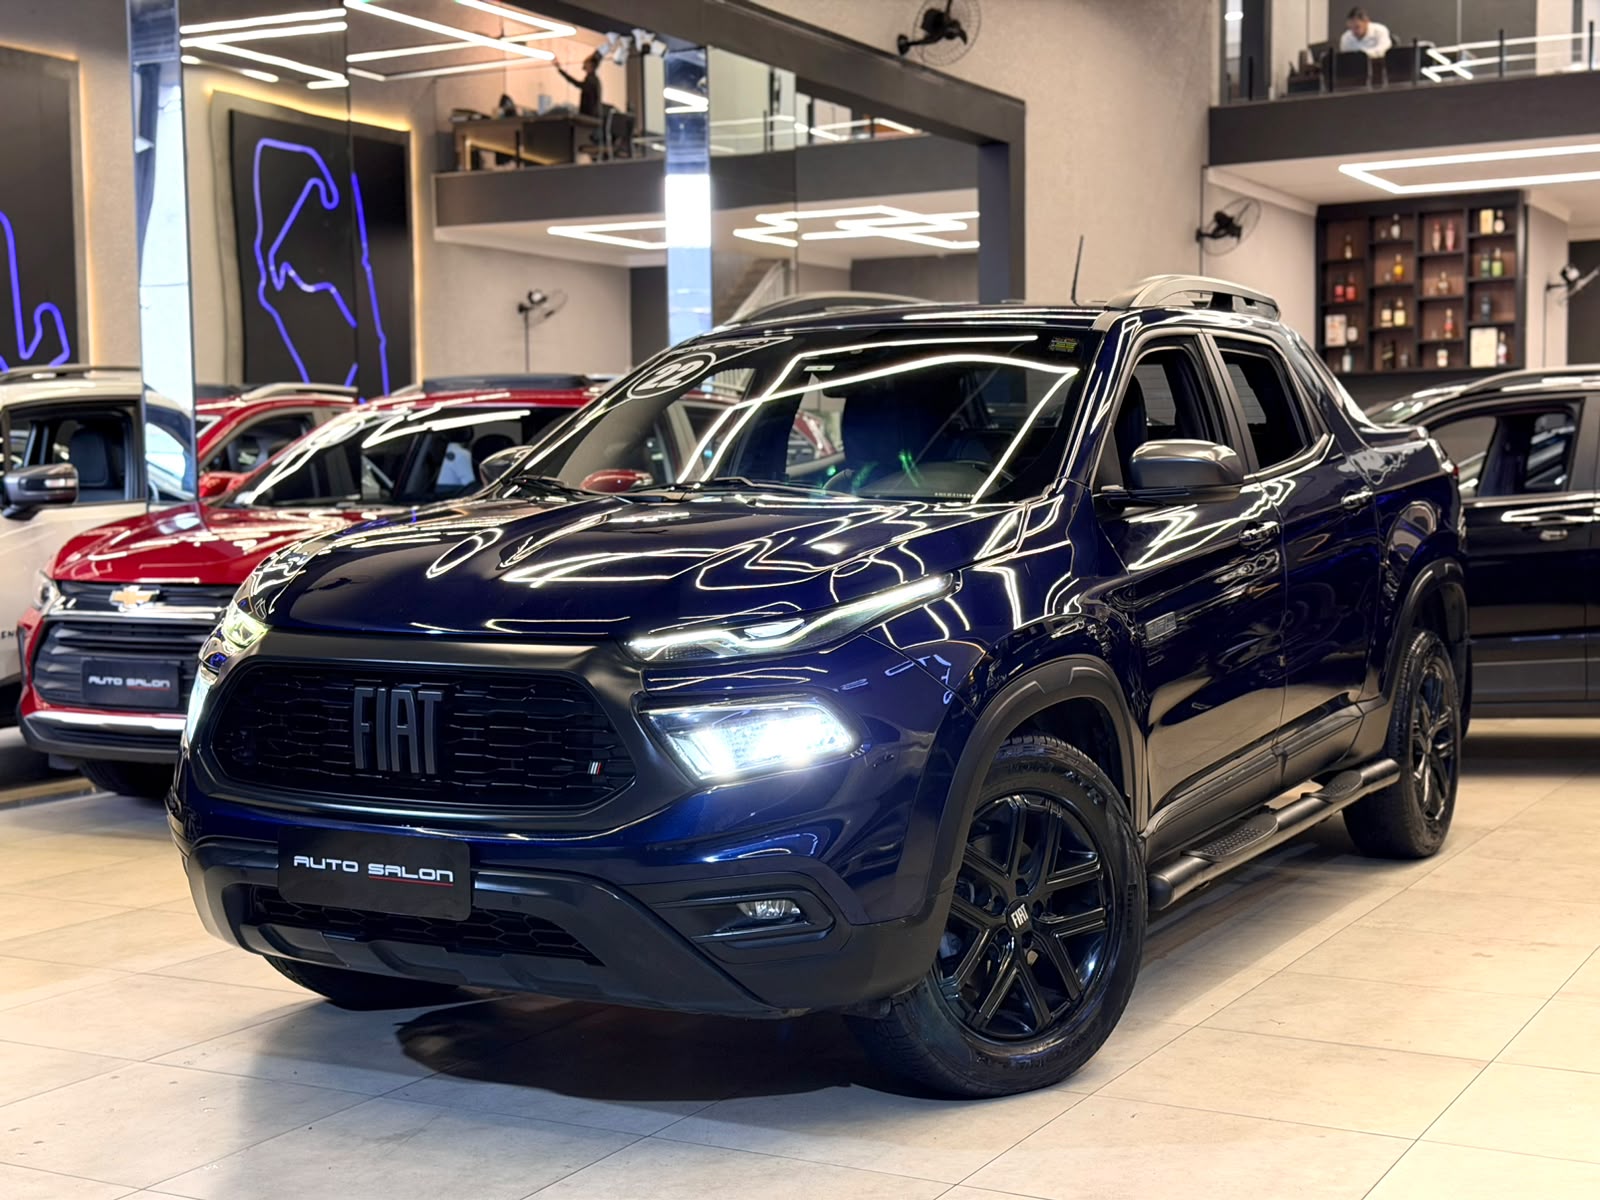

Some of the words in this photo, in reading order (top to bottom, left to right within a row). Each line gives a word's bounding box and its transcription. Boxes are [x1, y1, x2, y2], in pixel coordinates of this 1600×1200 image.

[634, 360, 704, 392] 22
[88, 675, 123, 686] AUTO
[126, 678, 171, 688] SALON
[353, 686, 443, 775] FIAT
[293, 855, 359, 873] AUTO
[367, 863, 454, 883] SALON
[1010, 903, 1029, 929] FIAT
